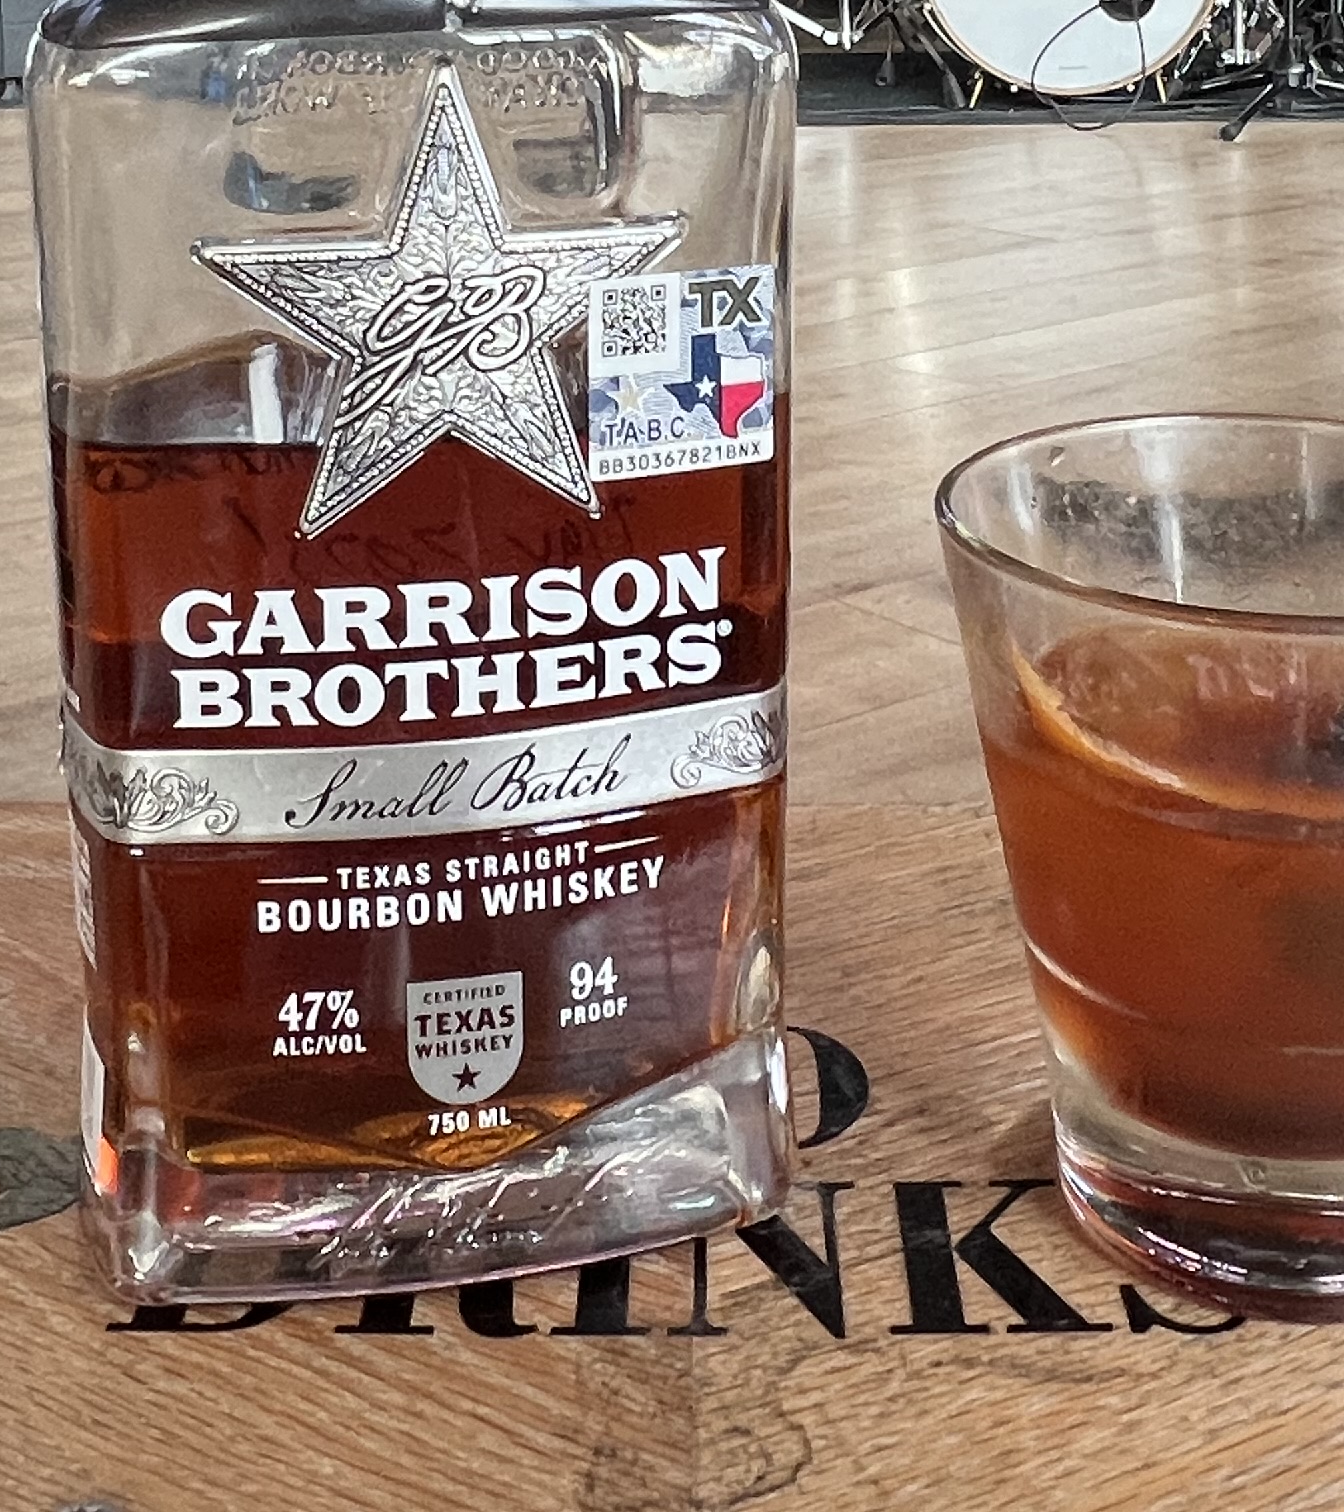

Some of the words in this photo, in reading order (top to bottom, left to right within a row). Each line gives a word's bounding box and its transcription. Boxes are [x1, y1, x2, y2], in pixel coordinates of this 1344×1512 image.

[687, 275, 763, 329] TX
[160, 546, 728, 659] GARRISON
[284, 757, 469, 828] Small
[470, 732, 629, 814] Batch
[336, 862, 432, 890] TEXAS
[444, 839, 591, 882] STRAIGHT
[256, 888, 463, 935] BOURBON
[480, 854, 666, 918] WHISKEY
[422, 984, 506, 1007] CERTIFIED
[568, 955, 619, 1003] 94
[277, 989, 360, 1034] 47%
[414, 1003, 517, 1039] TEXAS
[559, 995, 629, 1029] PROOF
[272, 1034, 368, 1058] ALC/VOL
[414, 1034, 514, 1061] WHISKEY
[427, 1109, 470, 1137] 750
[477, 1105, 513, 1129] ML
